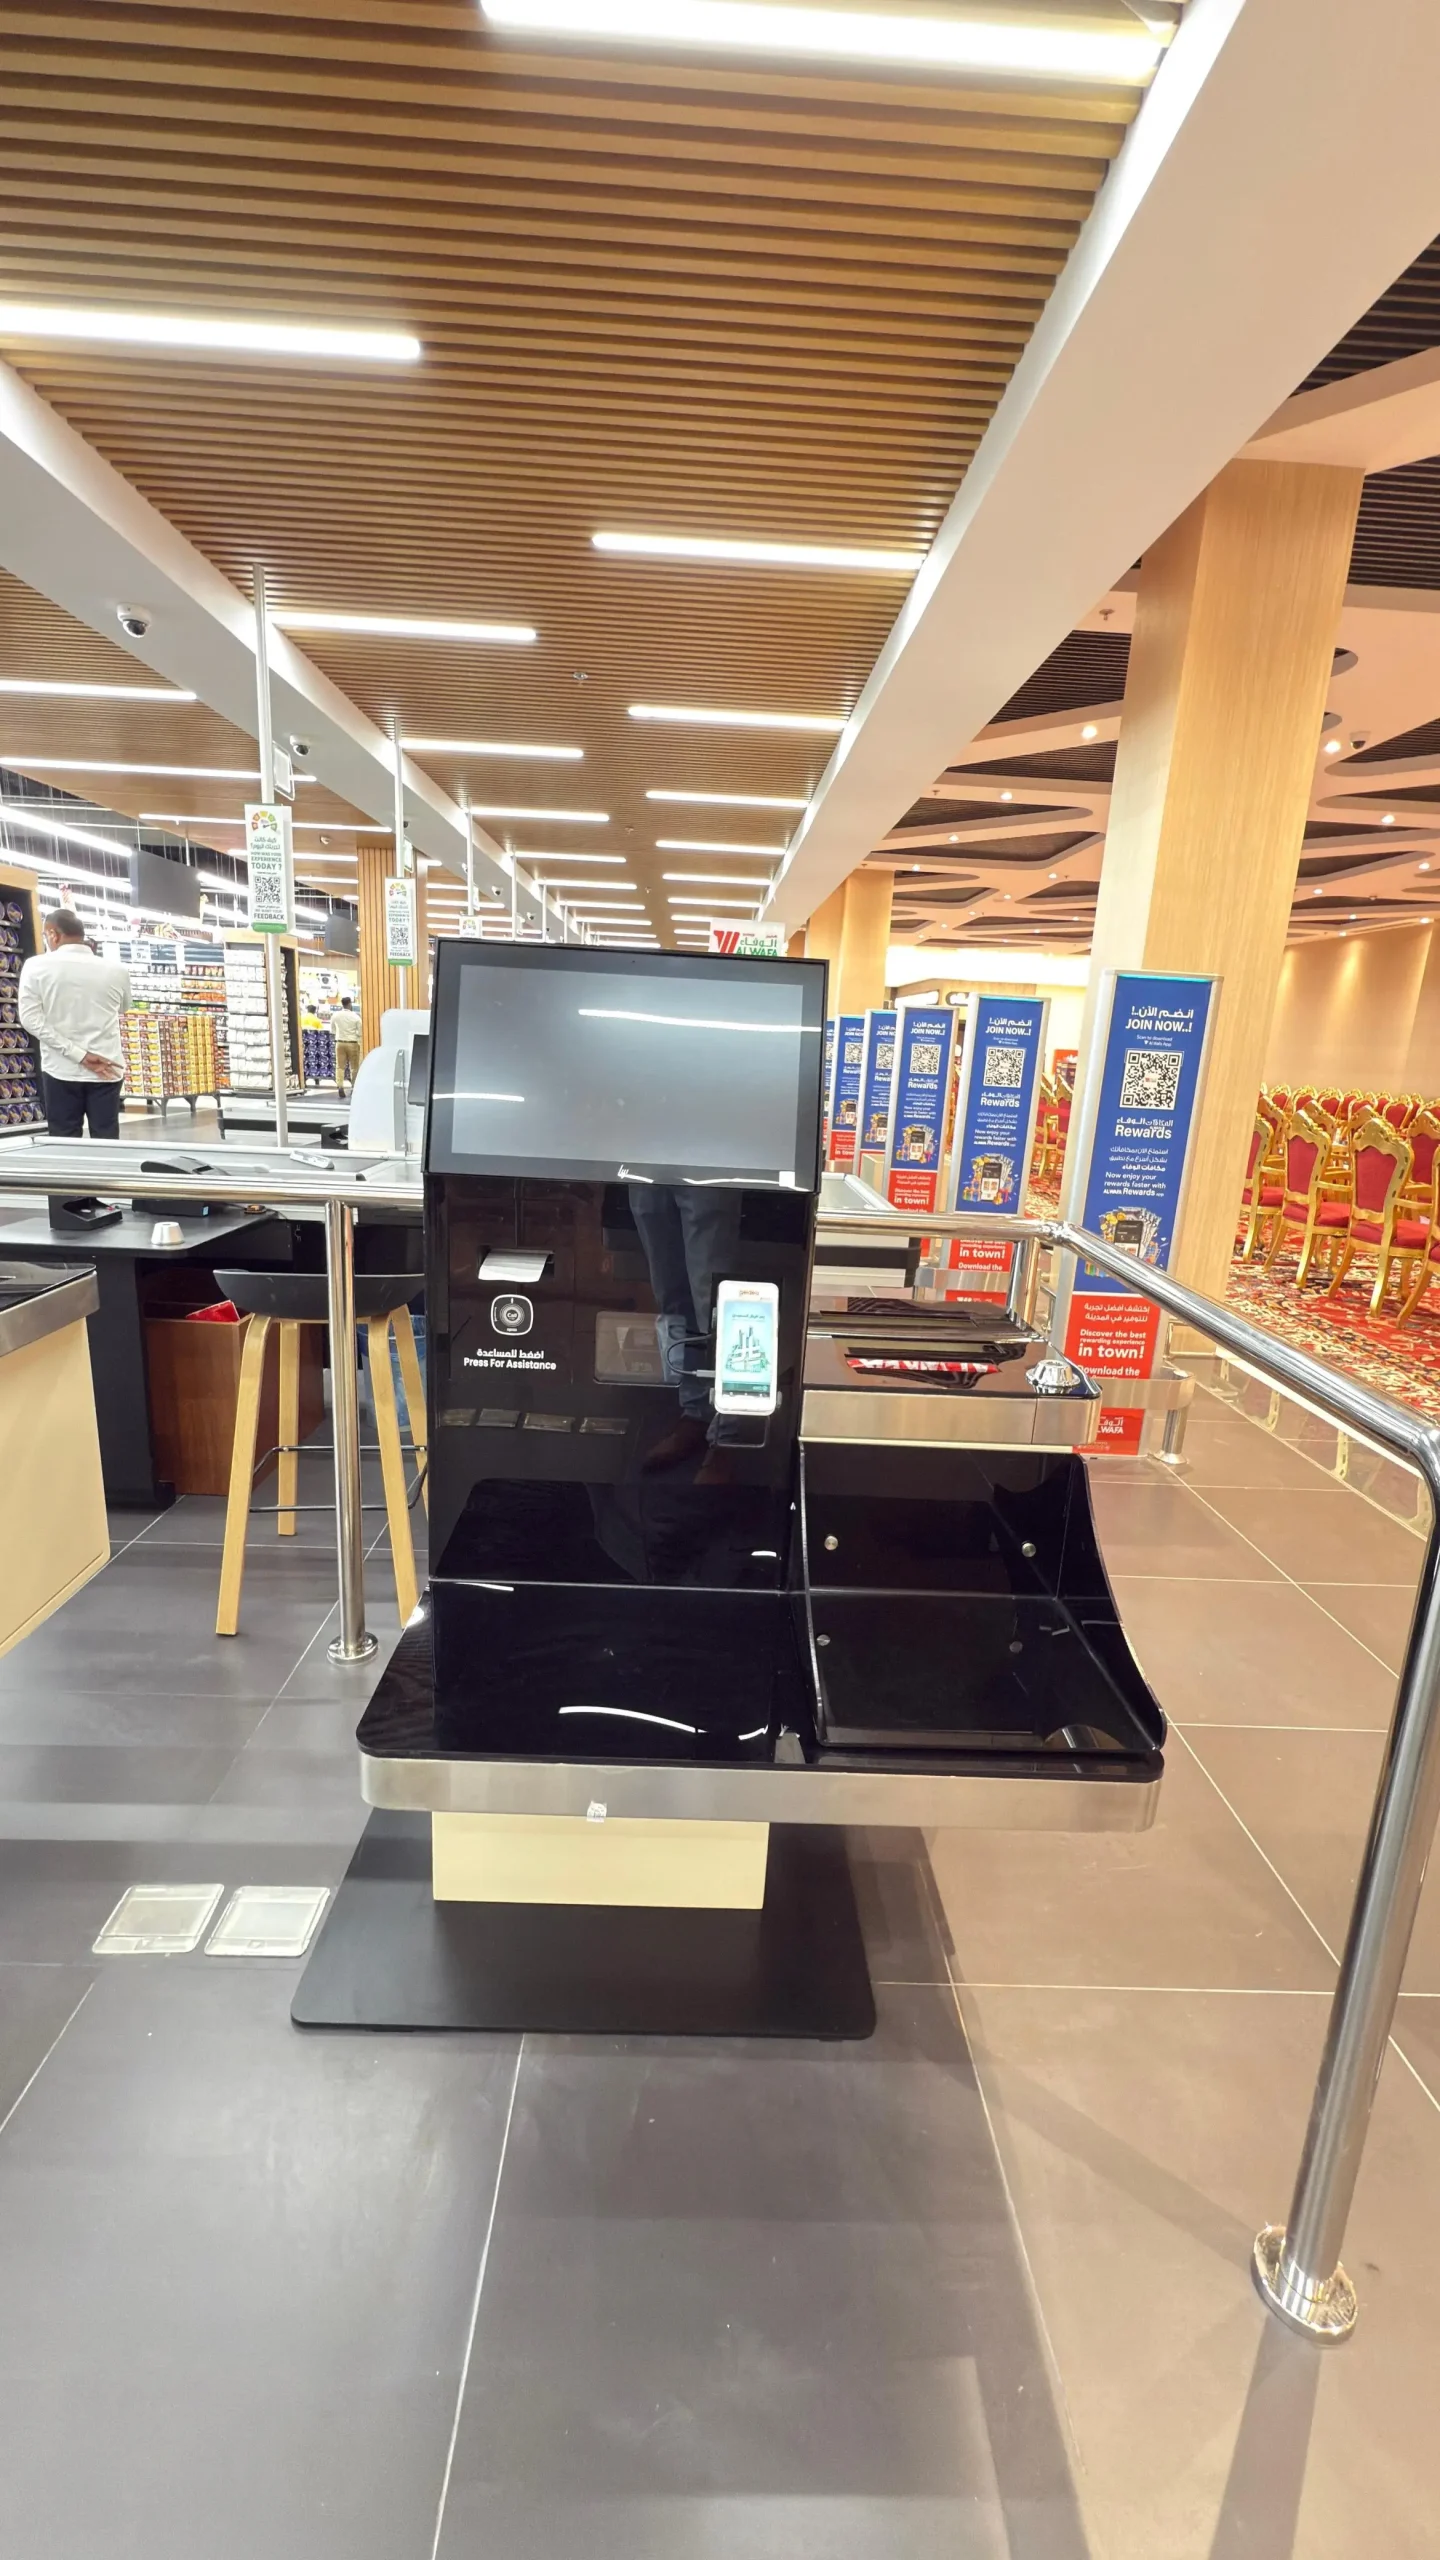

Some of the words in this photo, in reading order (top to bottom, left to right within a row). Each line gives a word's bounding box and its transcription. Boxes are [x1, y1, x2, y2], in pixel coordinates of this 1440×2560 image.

[251, 862, 276, 870] TODAY
[254, 912, 285, 920] FEEDBACK
[740, 936, 778, 948] الوفاء
[1158, 1008, 1194, 1019] انضم
[985, 1026, 1004, 1034] JOIN
[1125, 1018, 1152, 1030] JOIN
[1154, 1020, 1193, 1032] NOW..!
[908, 1082, 938, 1090] Rewards
[980, 1097, 1020, 1108] Rewards
[1114, 1125, 1172, 1139] Rewards
[1122, 1188, 1155, 1196] Rewards
[894, 1195, 902, 1204] in
[960, 1246, 970, 1256] in
[973, 1248, 1005, 1259] town!
[958, 1262, 991, 1270] Download
[477, 1348, 517, 1358] للمساعدة
[519, 1350, 545, 1359] اضغط
[1078, 1343, 1093, 1357] in
[1098, 1344, 1145, 1359] town!
[464, 1357, 489, 1367] Press
[490, 1359, 505, 1368] For
[506, 1359, 556, 1370] Assistance
[1125, 1366, 1140, 1376] the
[1097, 1426, 1124, 1434] WAFA
